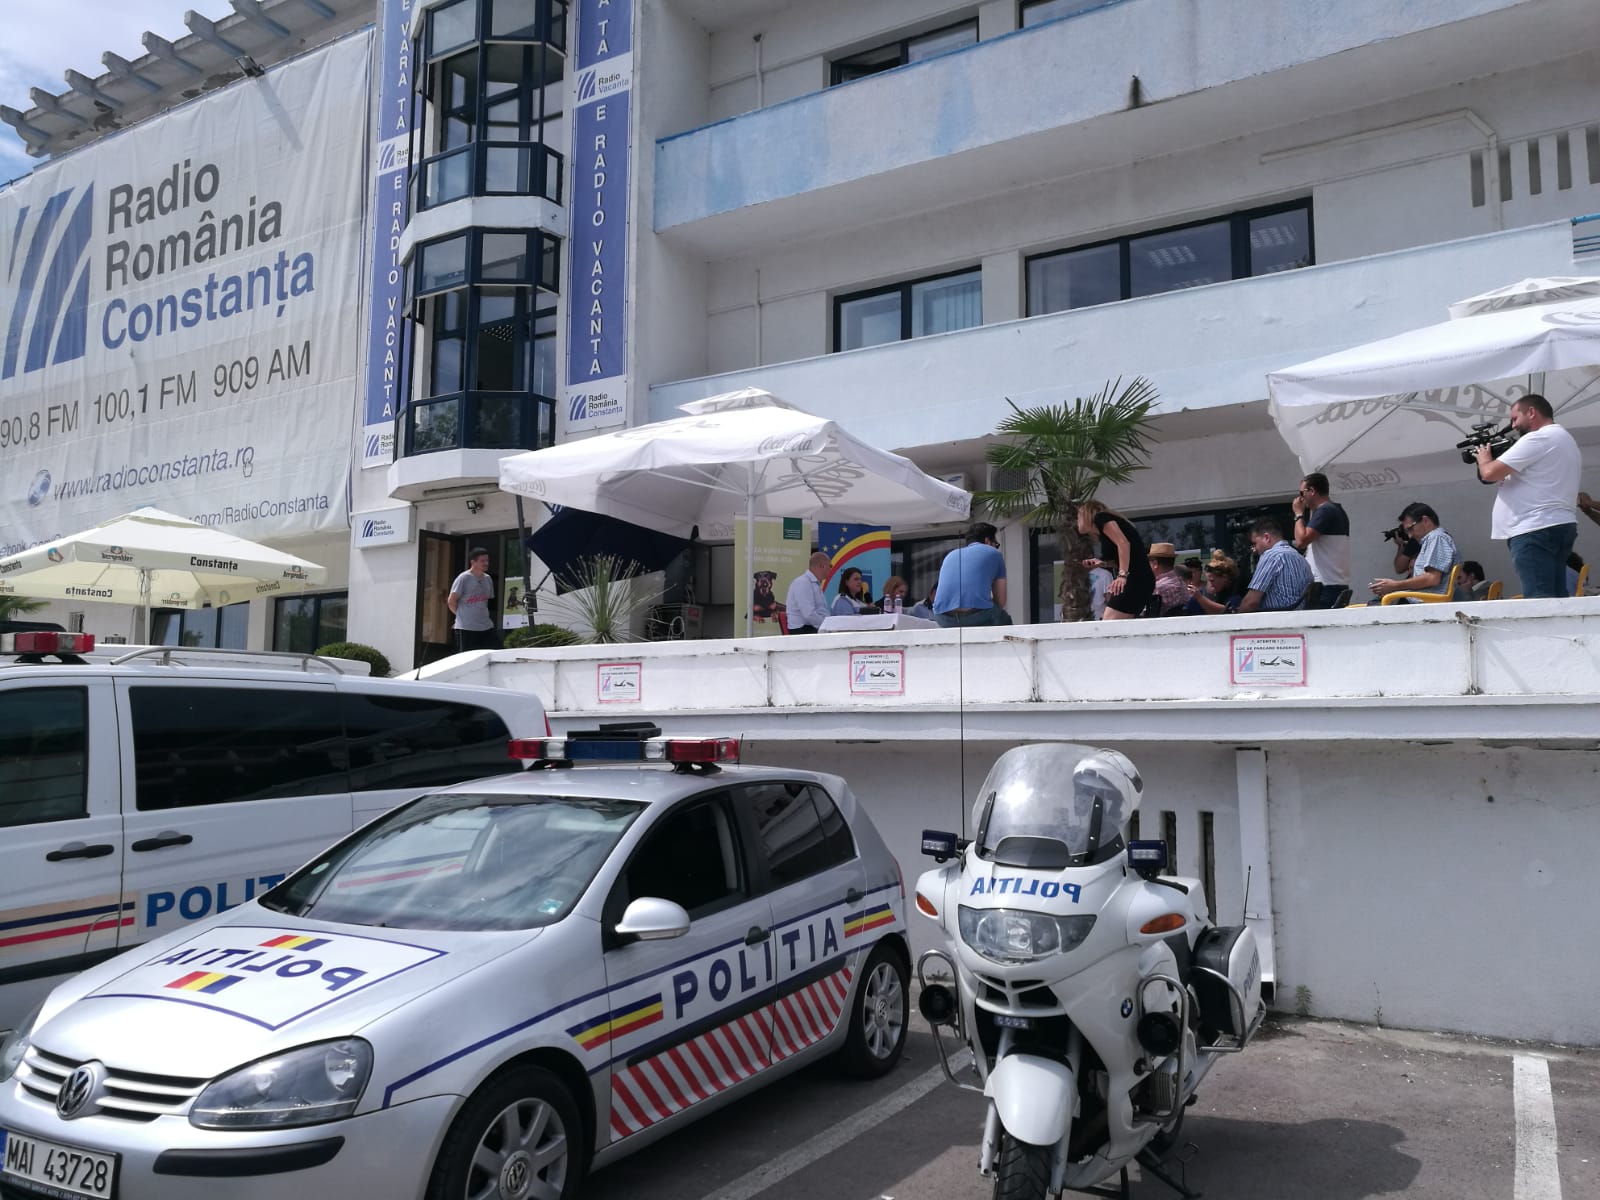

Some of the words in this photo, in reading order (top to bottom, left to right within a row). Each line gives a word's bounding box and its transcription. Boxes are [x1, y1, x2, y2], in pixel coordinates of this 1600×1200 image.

[397, 21, 410, 87] VARA
[597, 19, 609, 56] TA
[598, 73, 620, 86] Radio
[395, 98, 407, 130] TA
[596, 104, 607, 122] E
[108, 158, 220, 234] Radio
[394, 175, 402, 190] E
[592, 134, 607, 227] RADIO
[106, 196, 283, 291] România
[388, 201, 402, 285] RADIO
[102, 251, 315, 350] Constanța
[589, 239, 604, 376] VACANTA
[381, 296, 398, 418] VACANTA
[0, 413, 41, 448] 90,8
[48, 401, 79, 438] FM
[94, 384, 149, 426] 100,1
[160, 370, 197, 410] FM
[213, 356, 260, 398] 909
[267, 340, 311, 385] AM
[589, 393, 608, 402] Radio
[53, 446, 255, 502] www.radioconstanta.ro
[146, 872, 286, 927] POLIT
[672, 917, 839, 1020] POLITIA
[6, 1137, 35, 1176] MAI
[43, 1148, 109, 1193] 43728
